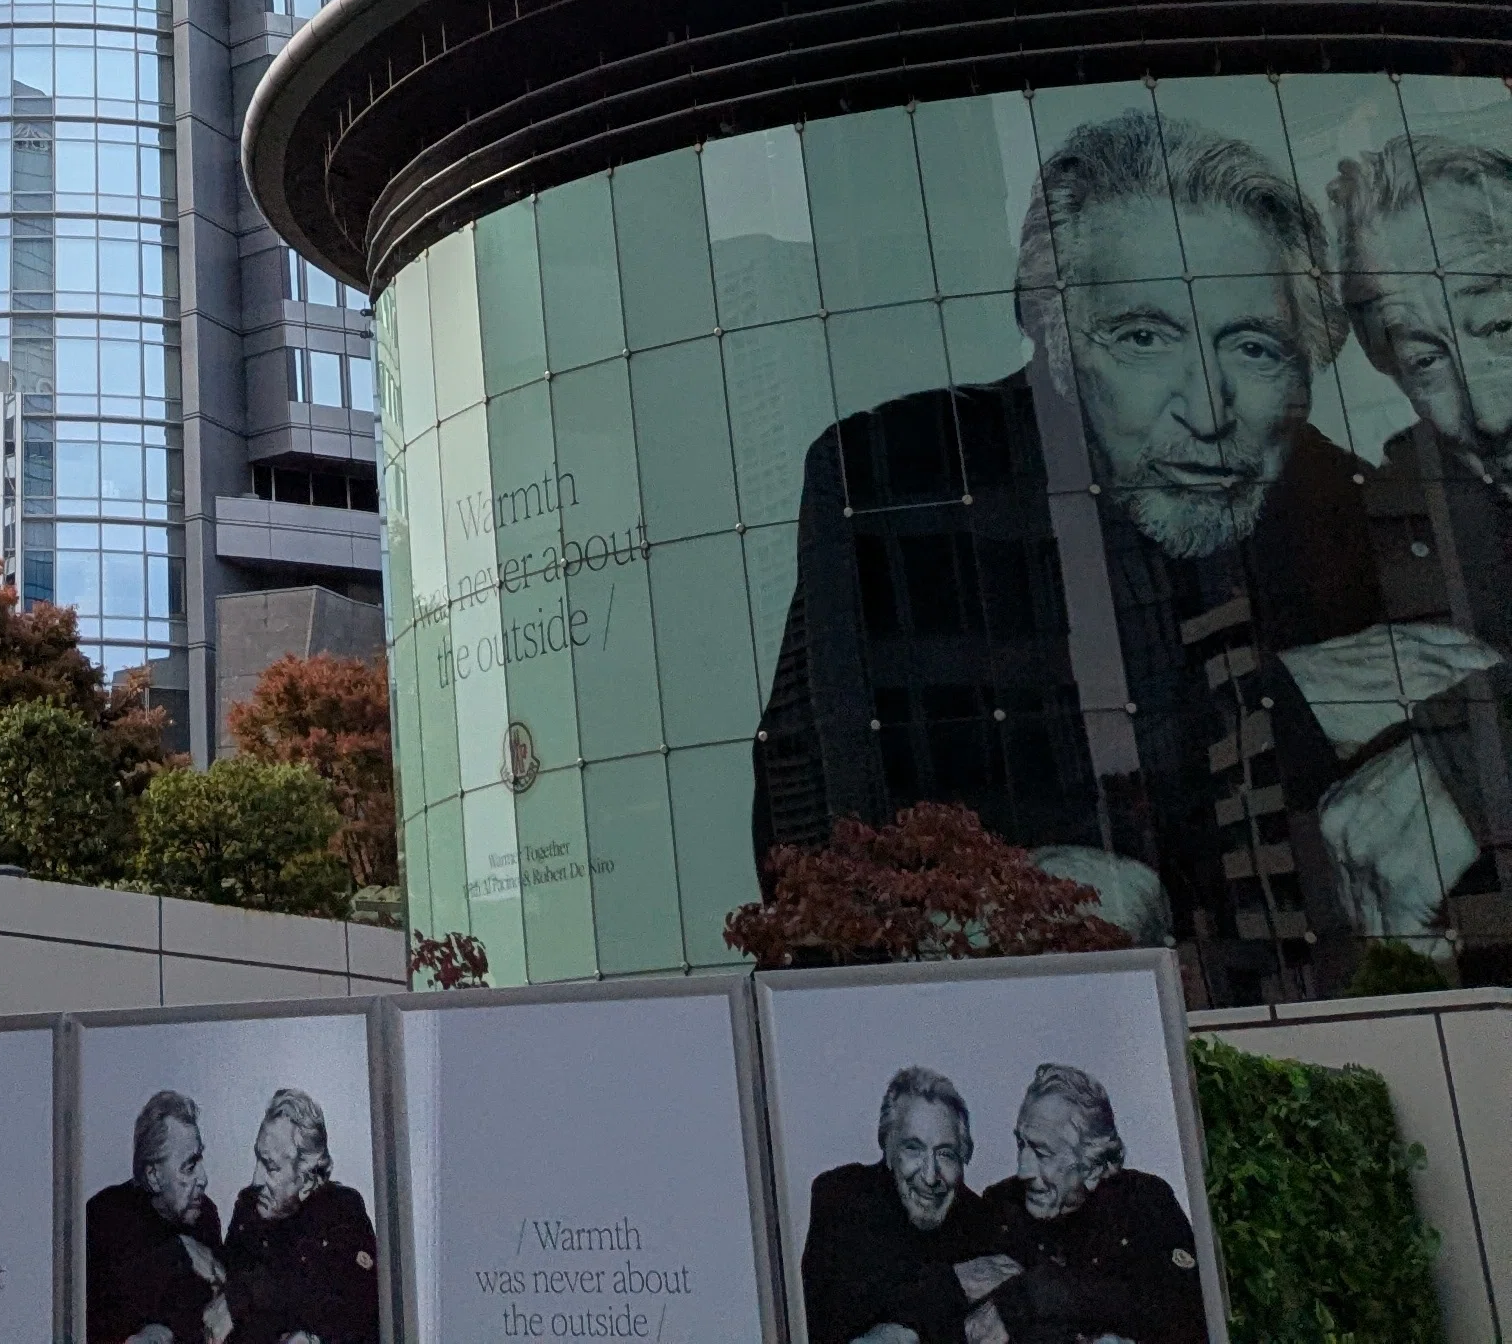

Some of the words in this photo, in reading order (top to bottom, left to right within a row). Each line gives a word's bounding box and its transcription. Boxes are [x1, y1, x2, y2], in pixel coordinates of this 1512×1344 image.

[456, 462, 580, 540] Warmth
[458, 553, 533, 612] never
[542, 515, 653, 584] about
[437, 635, 471, 689] the
[477, 596, 590, 673] outside
[533, 1215, 642, 1251] Warmth
[475, 1270, 526, 1294] was
[533, 1270, 605, 1294] never
[613, 1259, 692, 1294] about
[503, 1302, 543, 1337] the
[551, 1303, 649, 1338] outside
